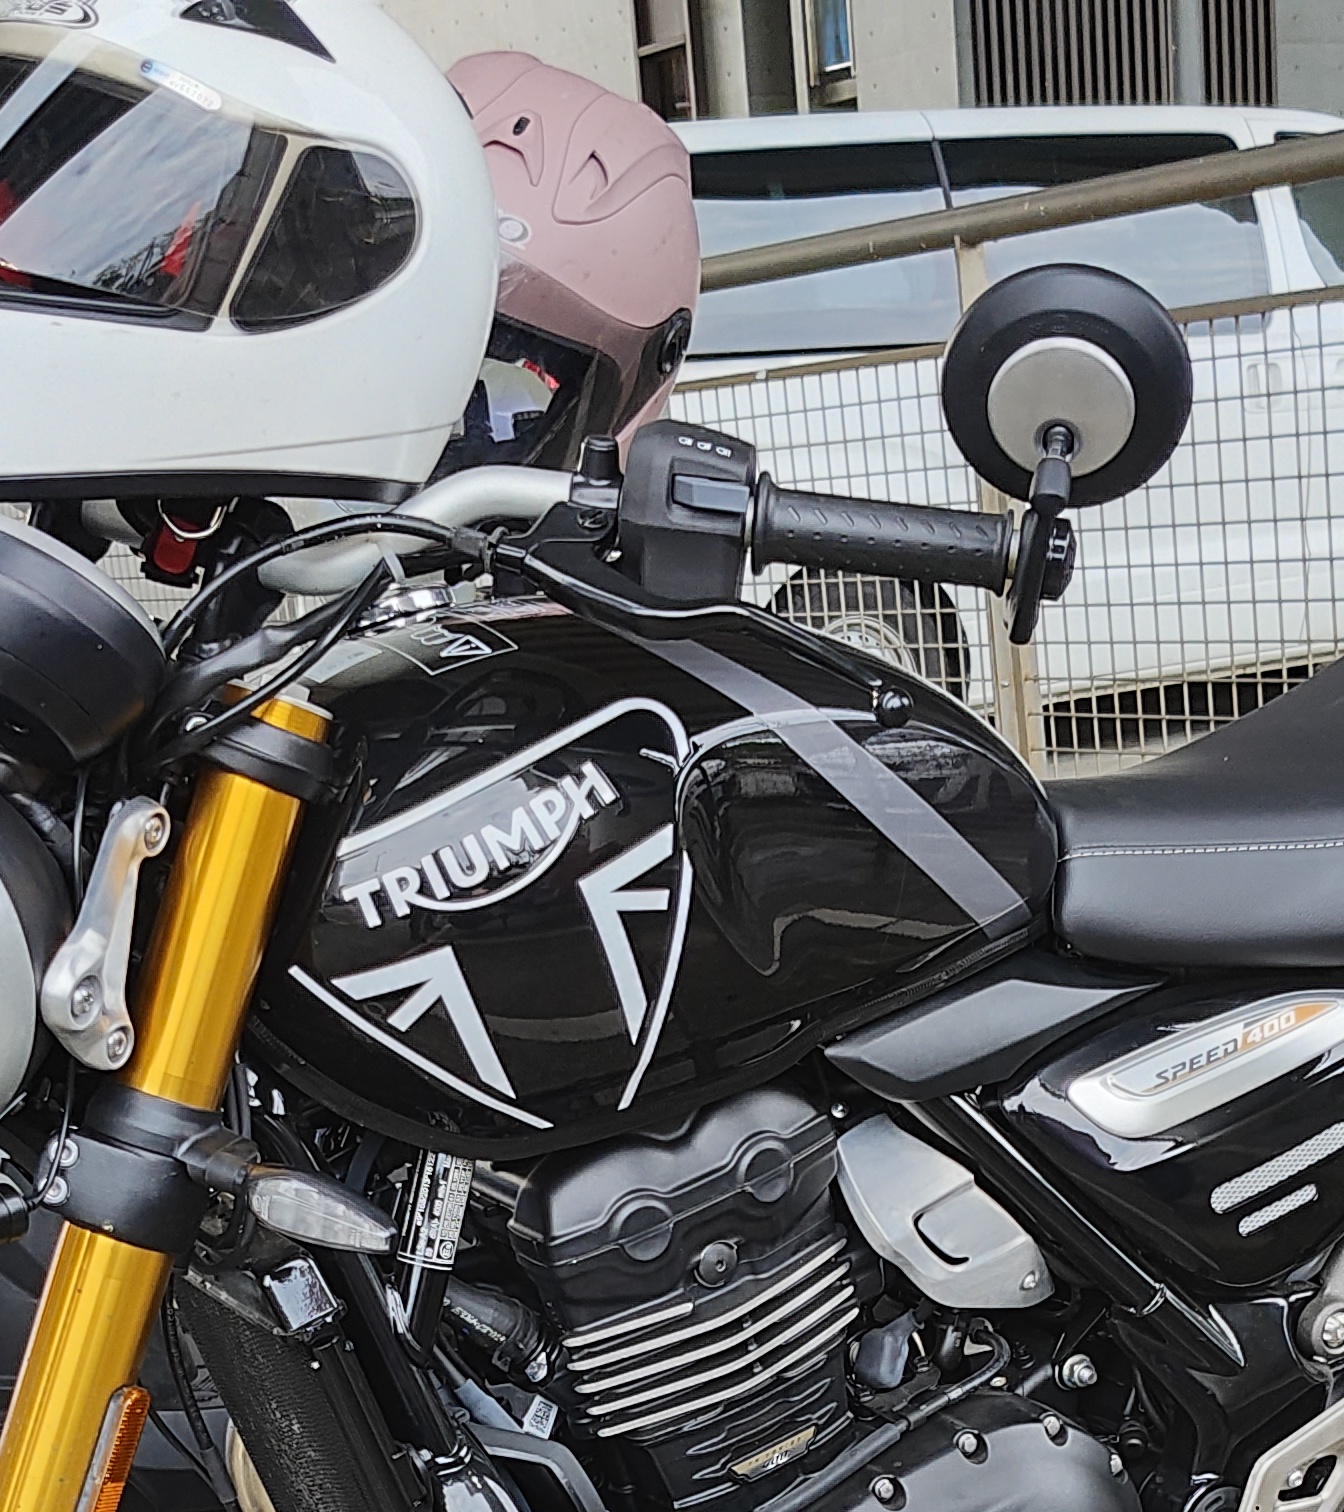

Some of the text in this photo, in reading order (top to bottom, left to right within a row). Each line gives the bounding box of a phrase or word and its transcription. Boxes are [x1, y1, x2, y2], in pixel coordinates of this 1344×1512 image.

[342, 761, 619, 929] TRIUMPH
[1154, 1010, 1298, 1088] SPEED 400
